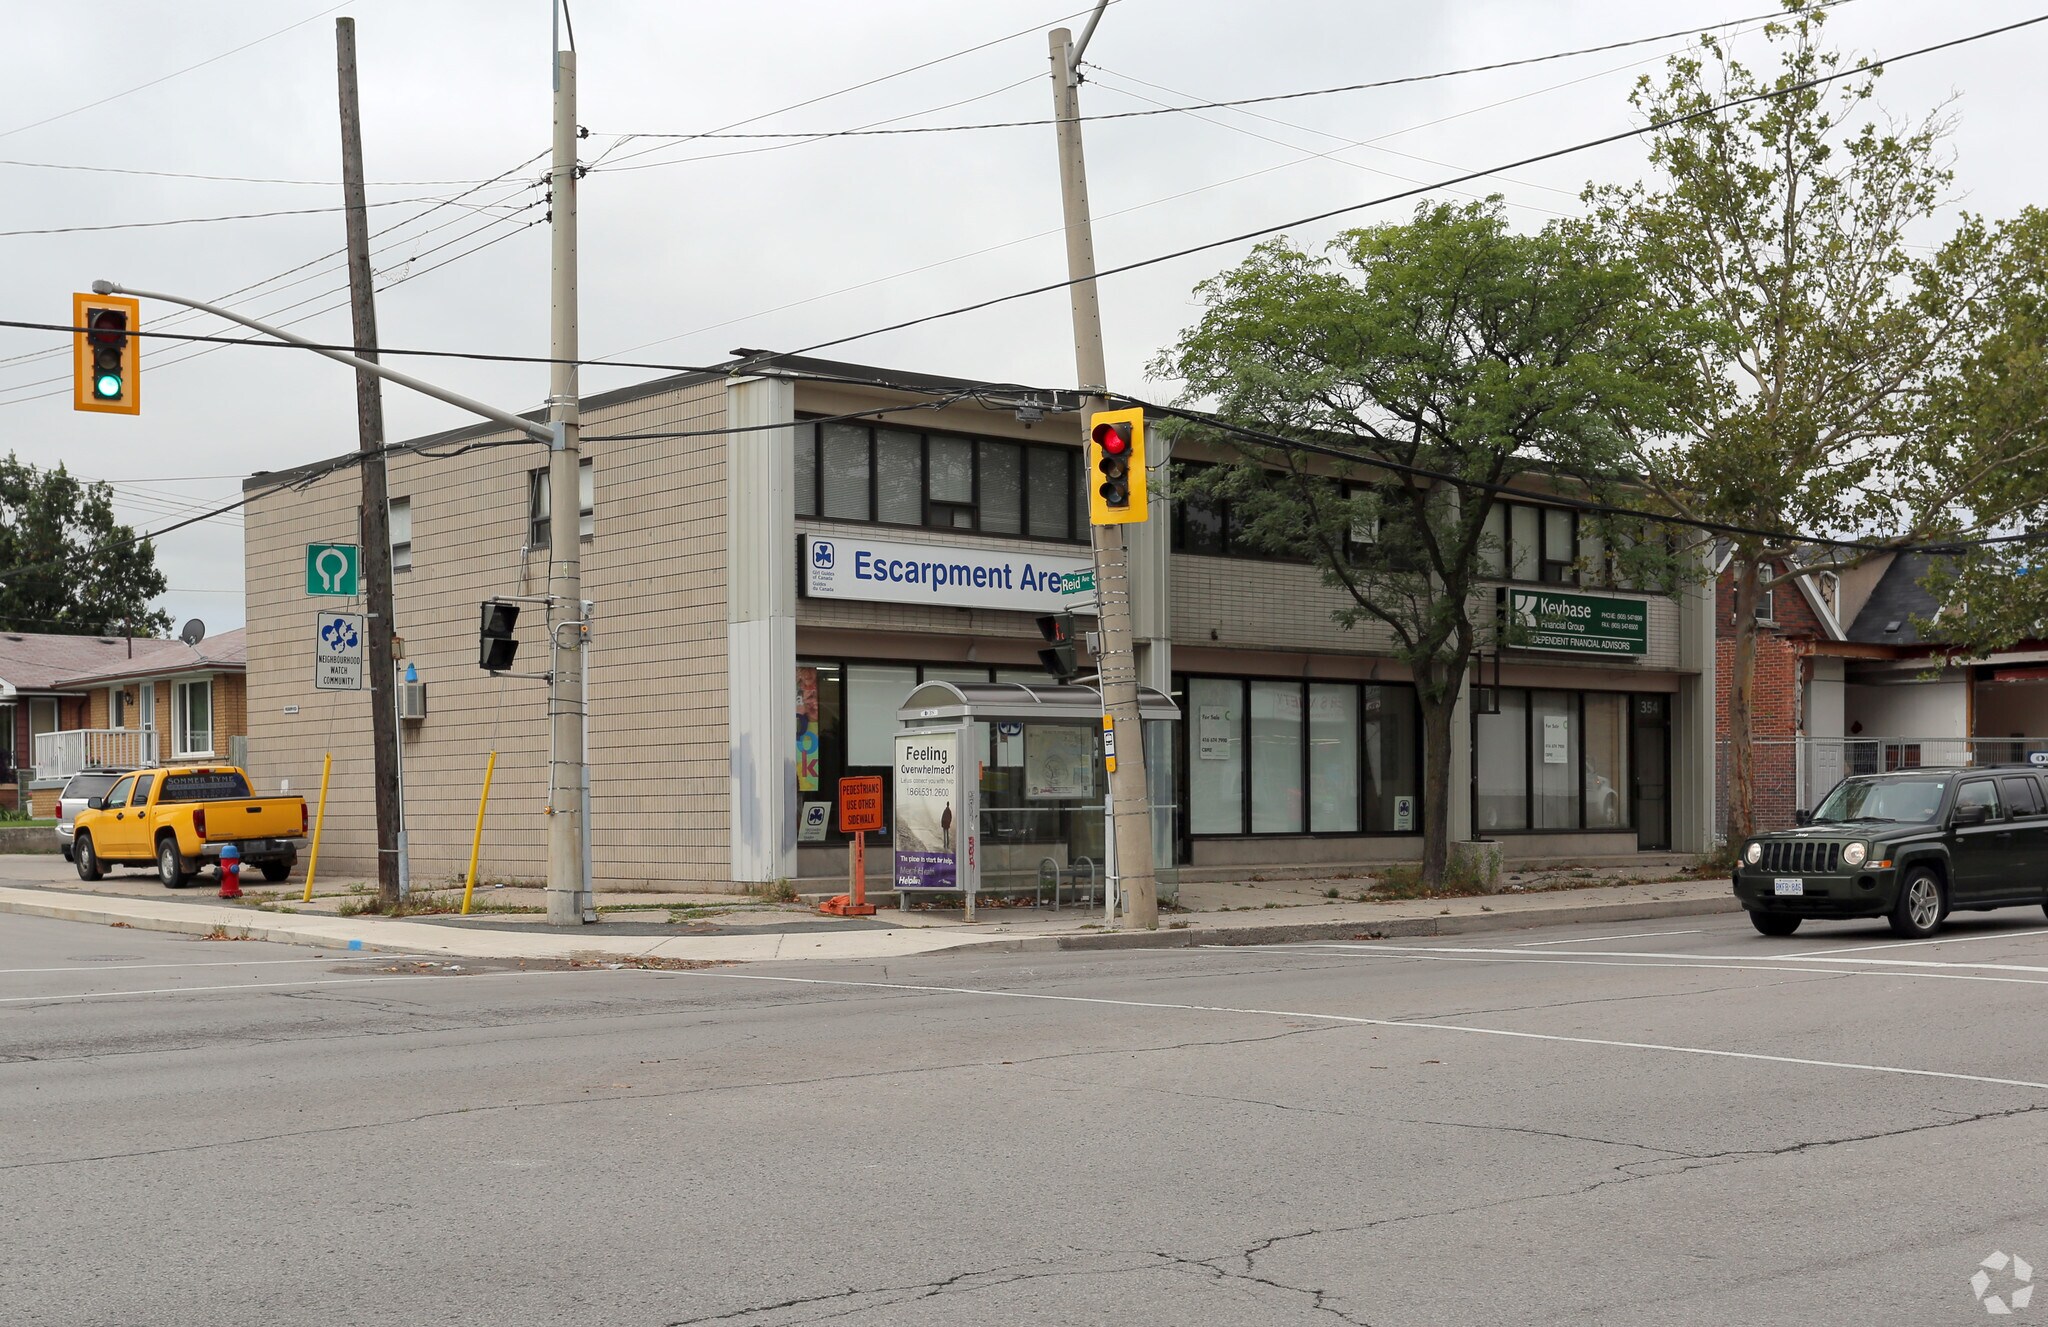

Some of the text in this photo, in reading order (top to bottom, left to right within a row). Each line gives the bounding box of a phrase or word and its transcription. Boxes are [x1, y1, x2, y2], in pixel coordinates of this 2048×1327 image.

[855, 551, 1069, 593] Escarpment Are
[1062, 576, 1081, 591] Reid
[1541, 620, 1585, 633] Financial Group
[1530, 635, 1631, 651] DEPENDENT FINANCIAL ADVISORS
[318, 655, 361, 665] NEIGHBOURHOOD
[330, 666, 348, 675] WATCH
[323, 676, 355, 685] COMMUNITY
[1640, 701, 1658, 713] 354
[906, 746, 948, 764] Feeling
[900, 764, 955, 775] Overwhelmed?
[842, 782, 880, 796] PEDESTRIANS
[846, 798, 876, 811] USE OTHER
[847, 812, 875, 826] SIDEWALK
